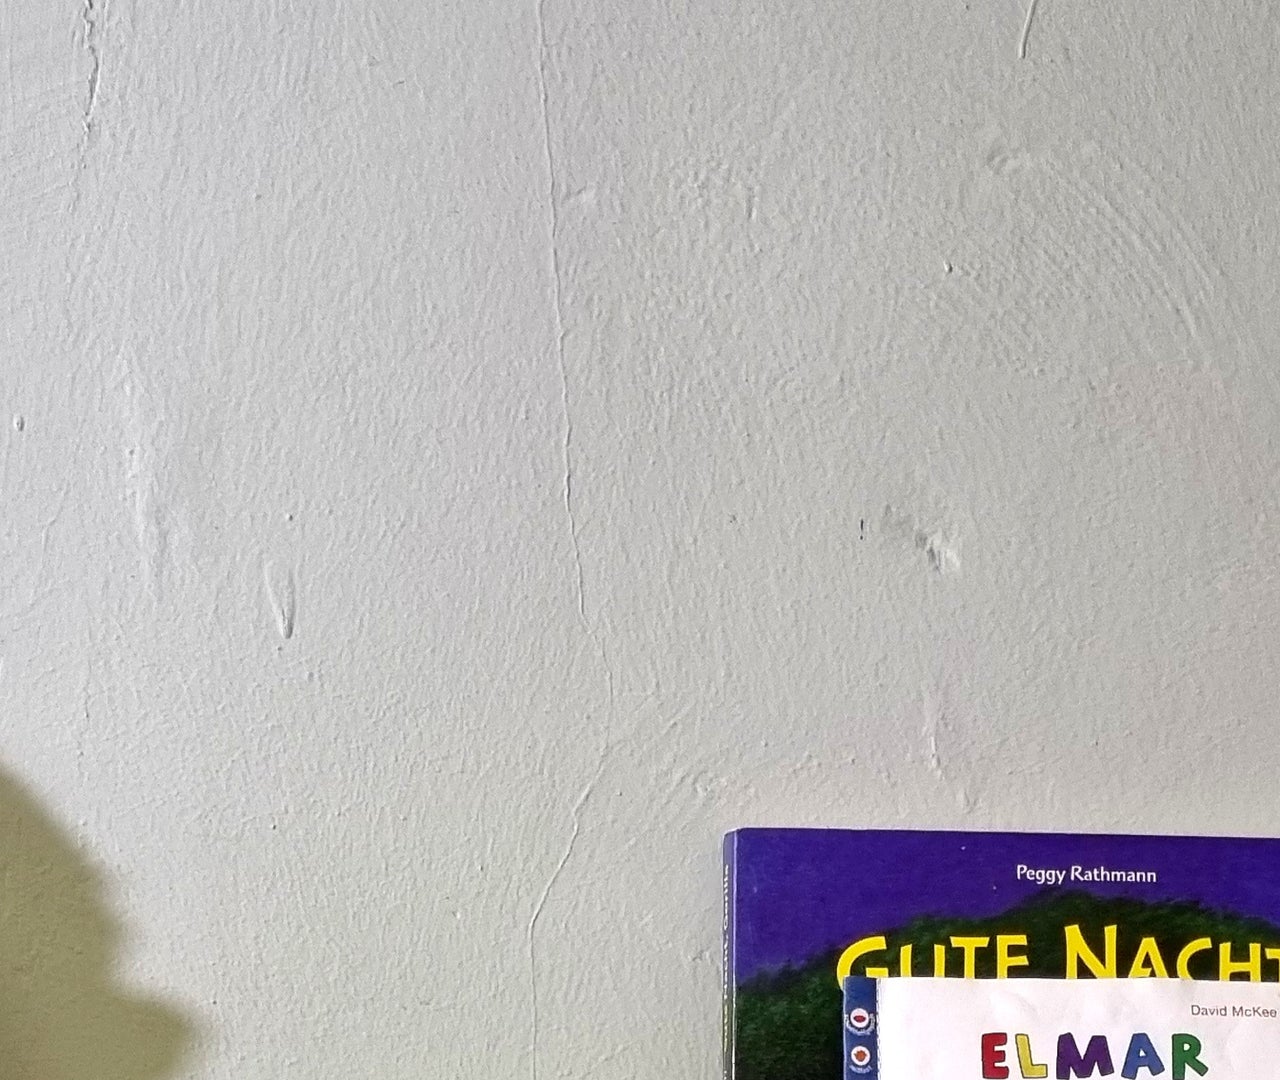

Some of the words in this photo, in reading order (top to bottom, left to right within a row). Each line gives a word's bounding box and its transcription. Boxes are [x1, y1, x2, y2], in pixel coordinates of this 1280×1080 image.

[1017, 864, 1066, 884] Peggy
[1070, 865, 1157, 882] Rathmann
[836, 934, 1029, 991] GUTE
[1191, 1004, 1228, 1017] David
[1232, 1005, 1277, 1018] McKee
[981, 1032, 1209, 1080] ELMAR
